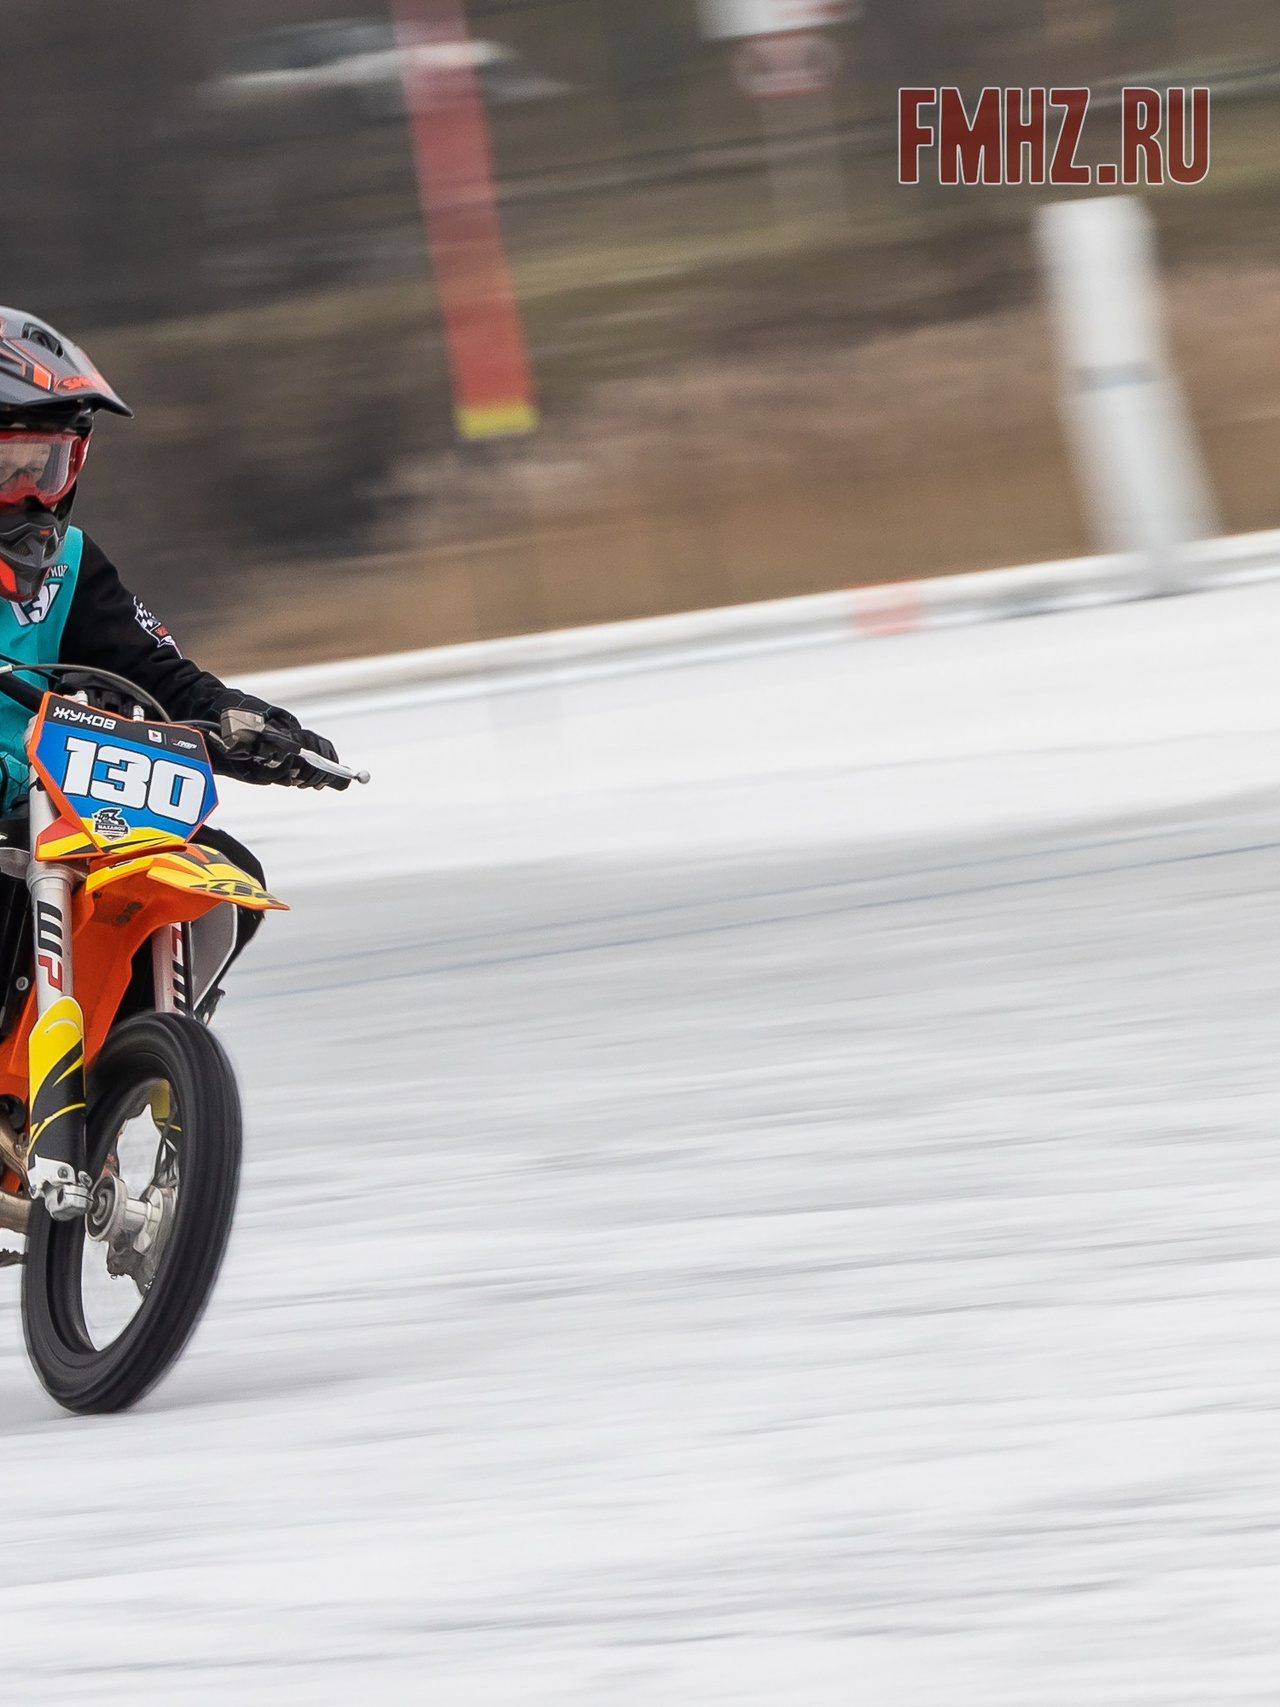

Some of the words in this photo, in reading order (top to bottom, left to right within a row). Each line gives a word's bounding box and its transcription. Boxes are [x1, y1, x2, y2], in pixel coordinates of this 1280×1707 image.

[52, 705, 117, 731] ЖУКОВ
[63, 735, 207, 826] 130
[36, 900, 63, 993] WP
